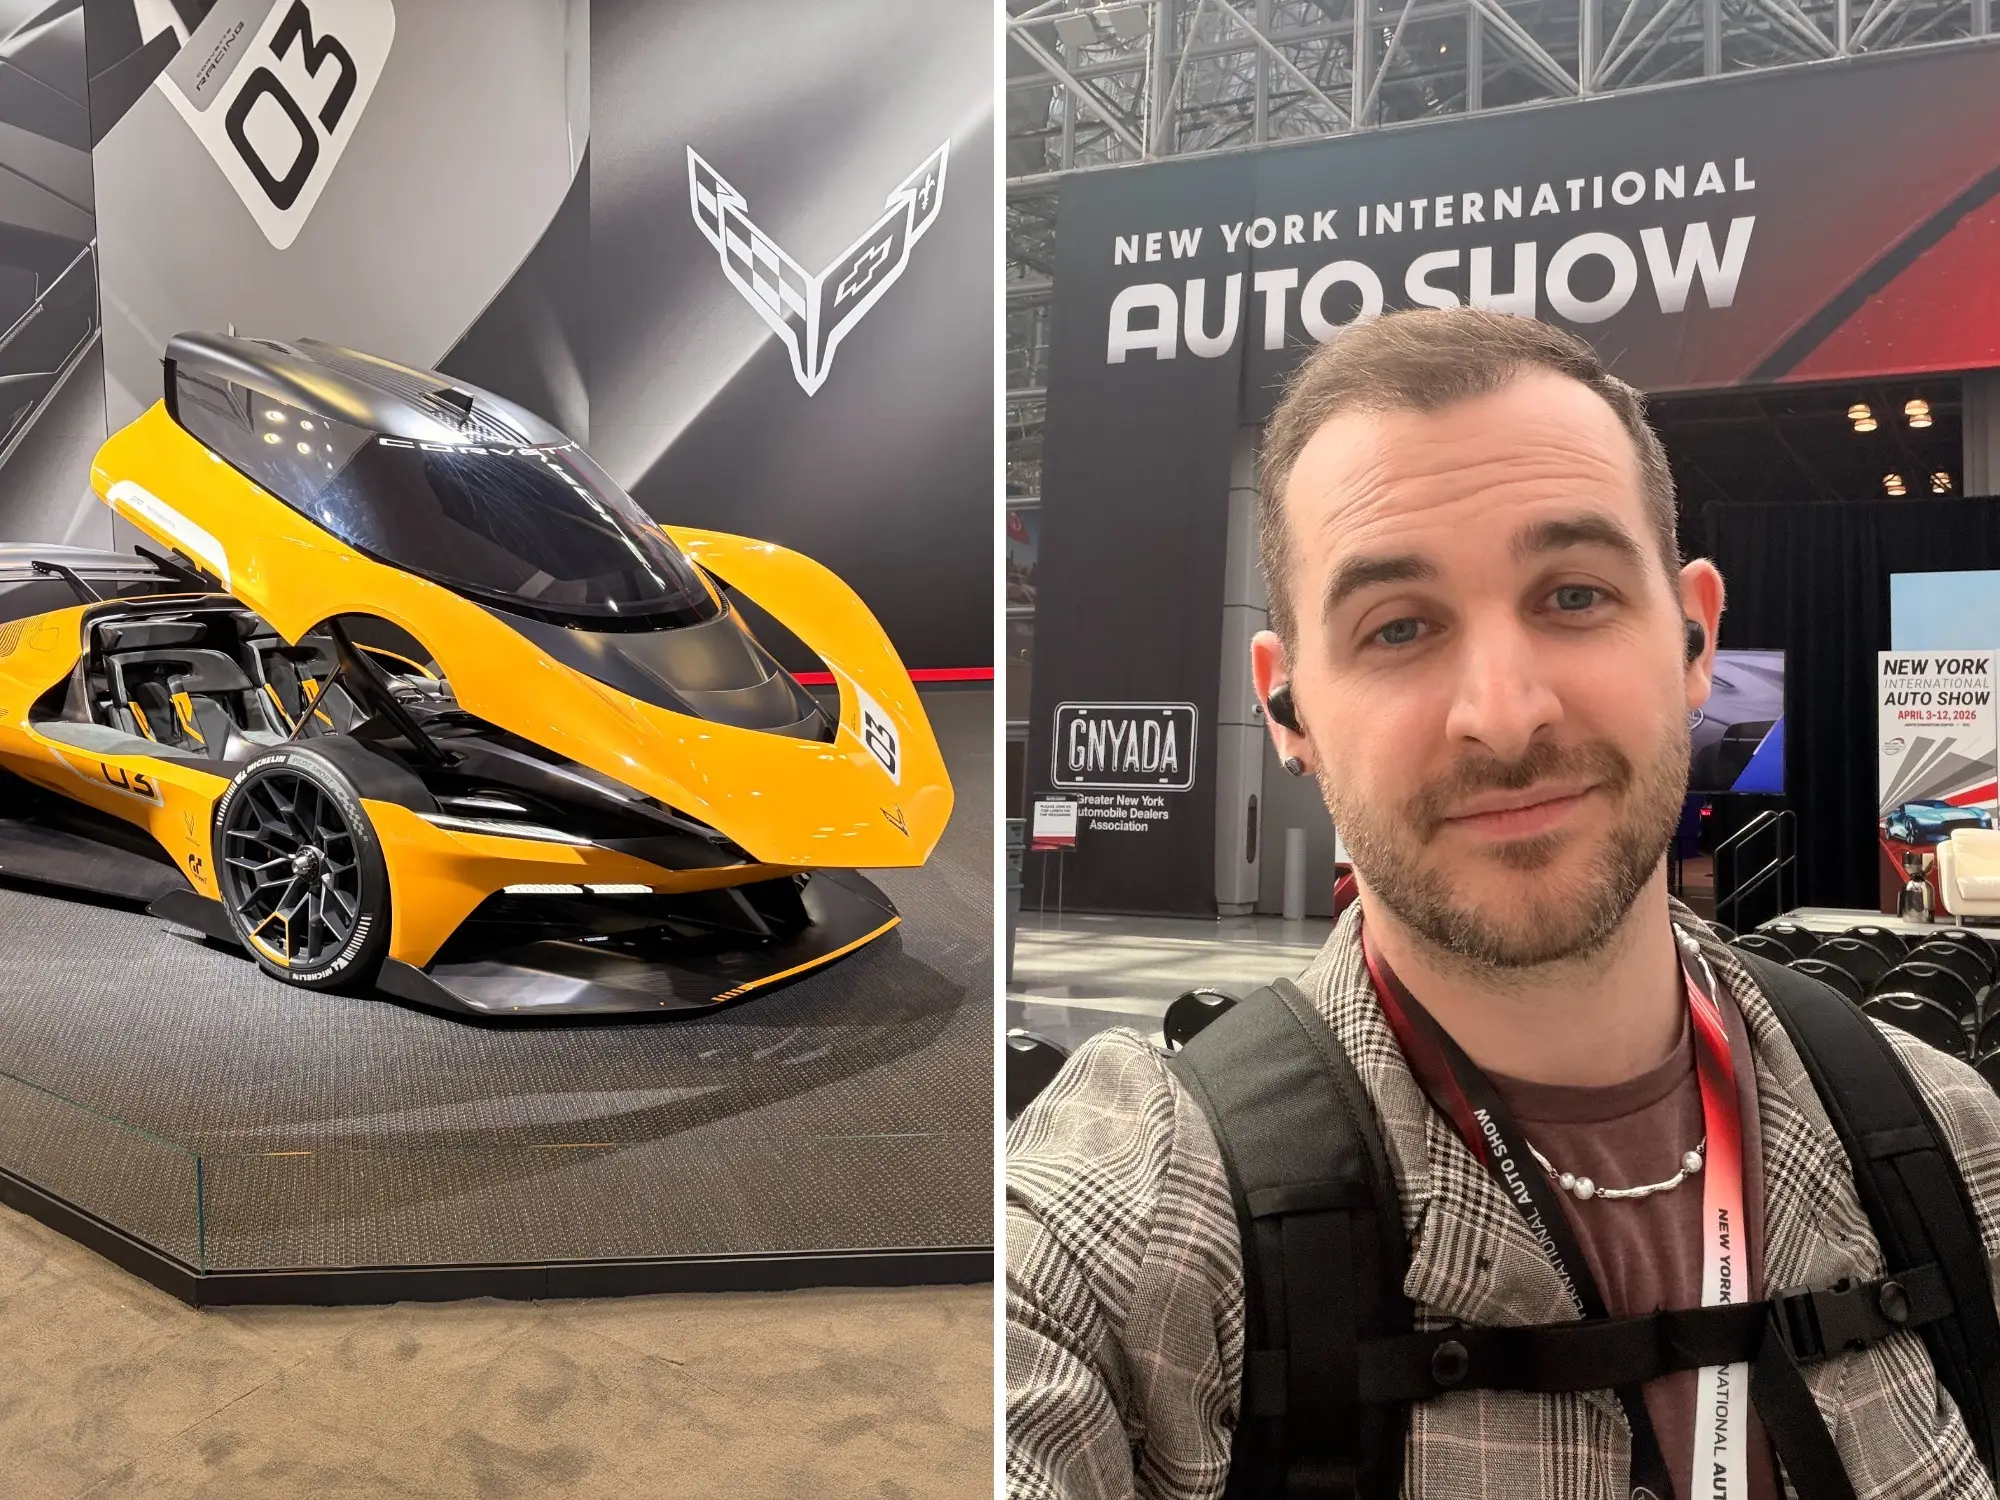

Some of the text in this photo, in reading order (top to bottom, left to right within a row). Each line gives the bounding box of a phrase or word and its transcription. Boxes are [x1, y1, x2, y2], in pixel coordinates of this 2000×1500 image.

[196, 20, 245, 91] RACING
[225, 0, 357, 211] 03
[1113, 157, 1756, 265] NEW YORK INTERNATIONAL
[1107, 216, 1757, 364] AUTO SHOW
[1883, 658, 1989, 675] NEW YORK
[1884, 677, 1990, 689] INTERNATIONAL
[1884, 690, 1991, 706] AUTO SHOW
[1897, 710, 1924, 720] APRIL
[1953, 710, 1977, 720] 2026
[864, 710, 896, 775] 03
[1068, 719, 1178, 773] GNYADA
[247, 755, 287, 774] MICHELIN
[311, 766, 335, 785] SPORT
[1076, 793, 1165, 807] Greater New York
[1077, 806, 1169, 820] utomobile Dealers
[1089, 819, 1149, 832] Association
[292, 966, 334, 981] MICHELIN
[1474, 1108, 1508, 1157] SHOW
[1500, 1158, 1533, 1205] AUTO
[1718, 1208, 1732, 1304] NEW YORK
